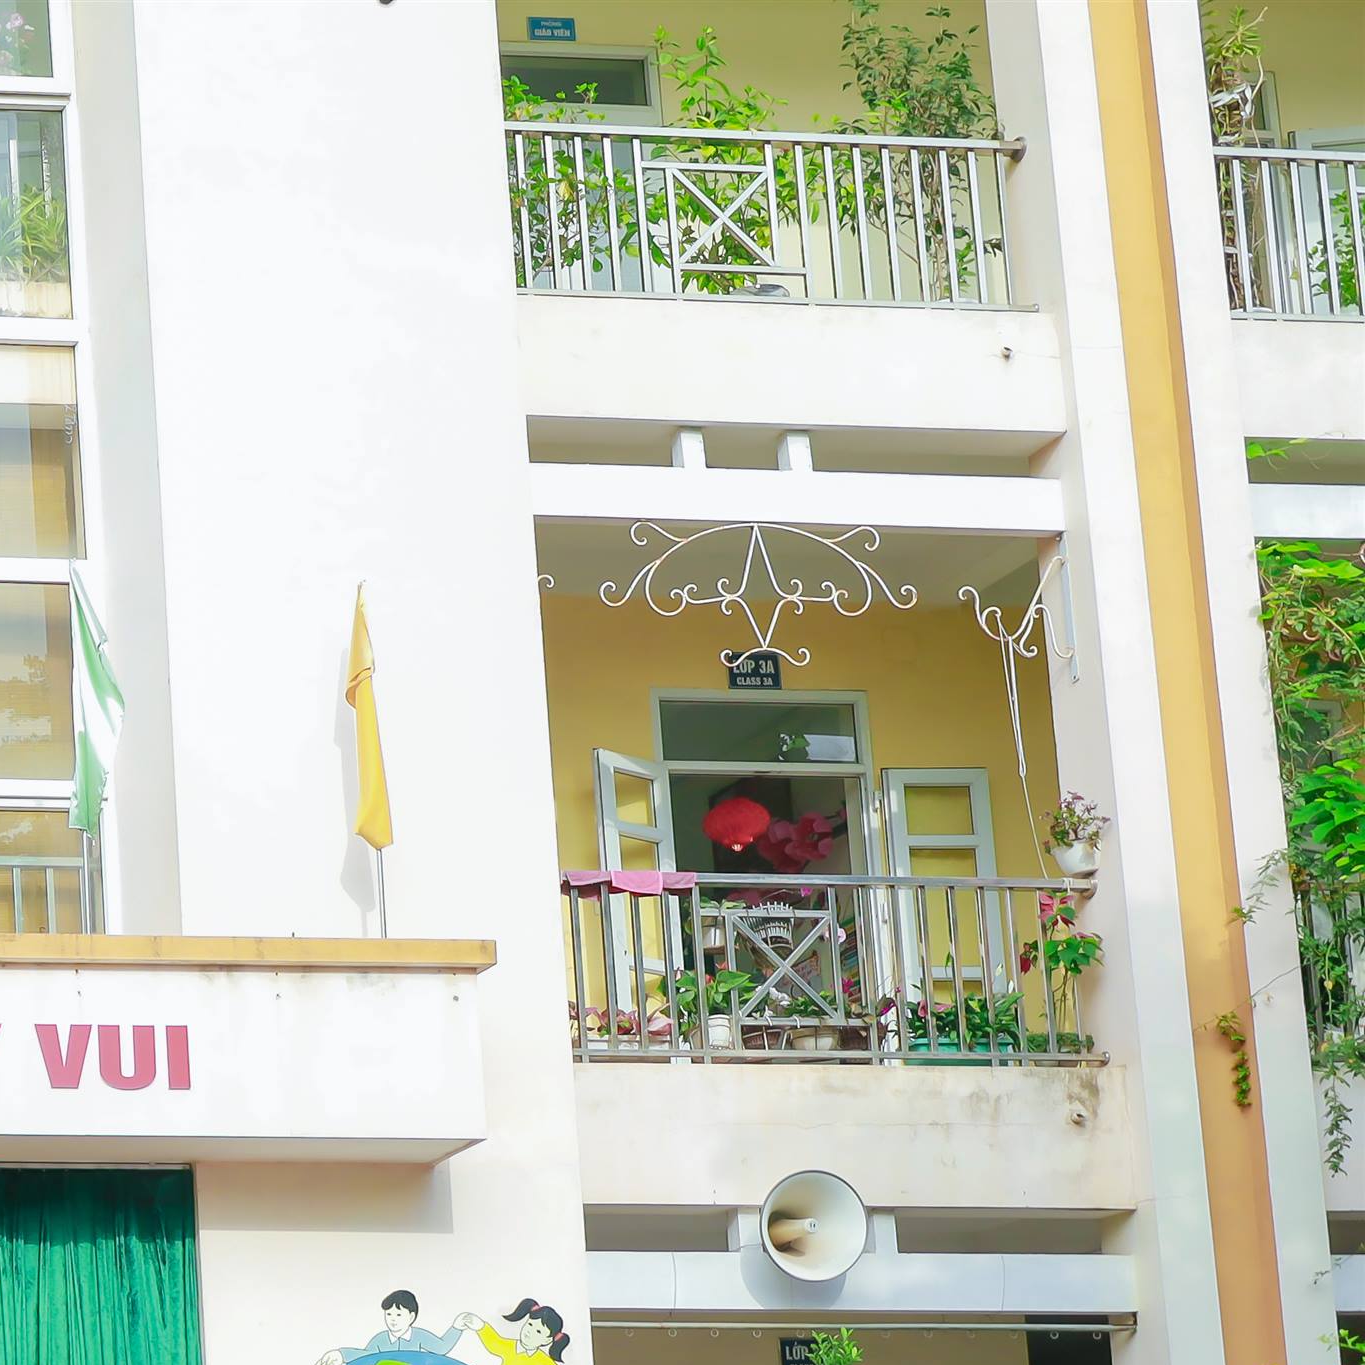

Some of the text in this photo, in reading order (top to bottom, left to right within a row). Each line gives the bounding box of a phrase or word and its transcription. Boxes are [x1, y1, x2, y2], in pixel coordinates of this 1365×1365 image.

[759, 660, 775, 674] 3A
[736, 676, 773, 686] CLASS 3A
[34, 1023, 192, 1091] VUI
[785, 1340, 809, 1360] LỚP
